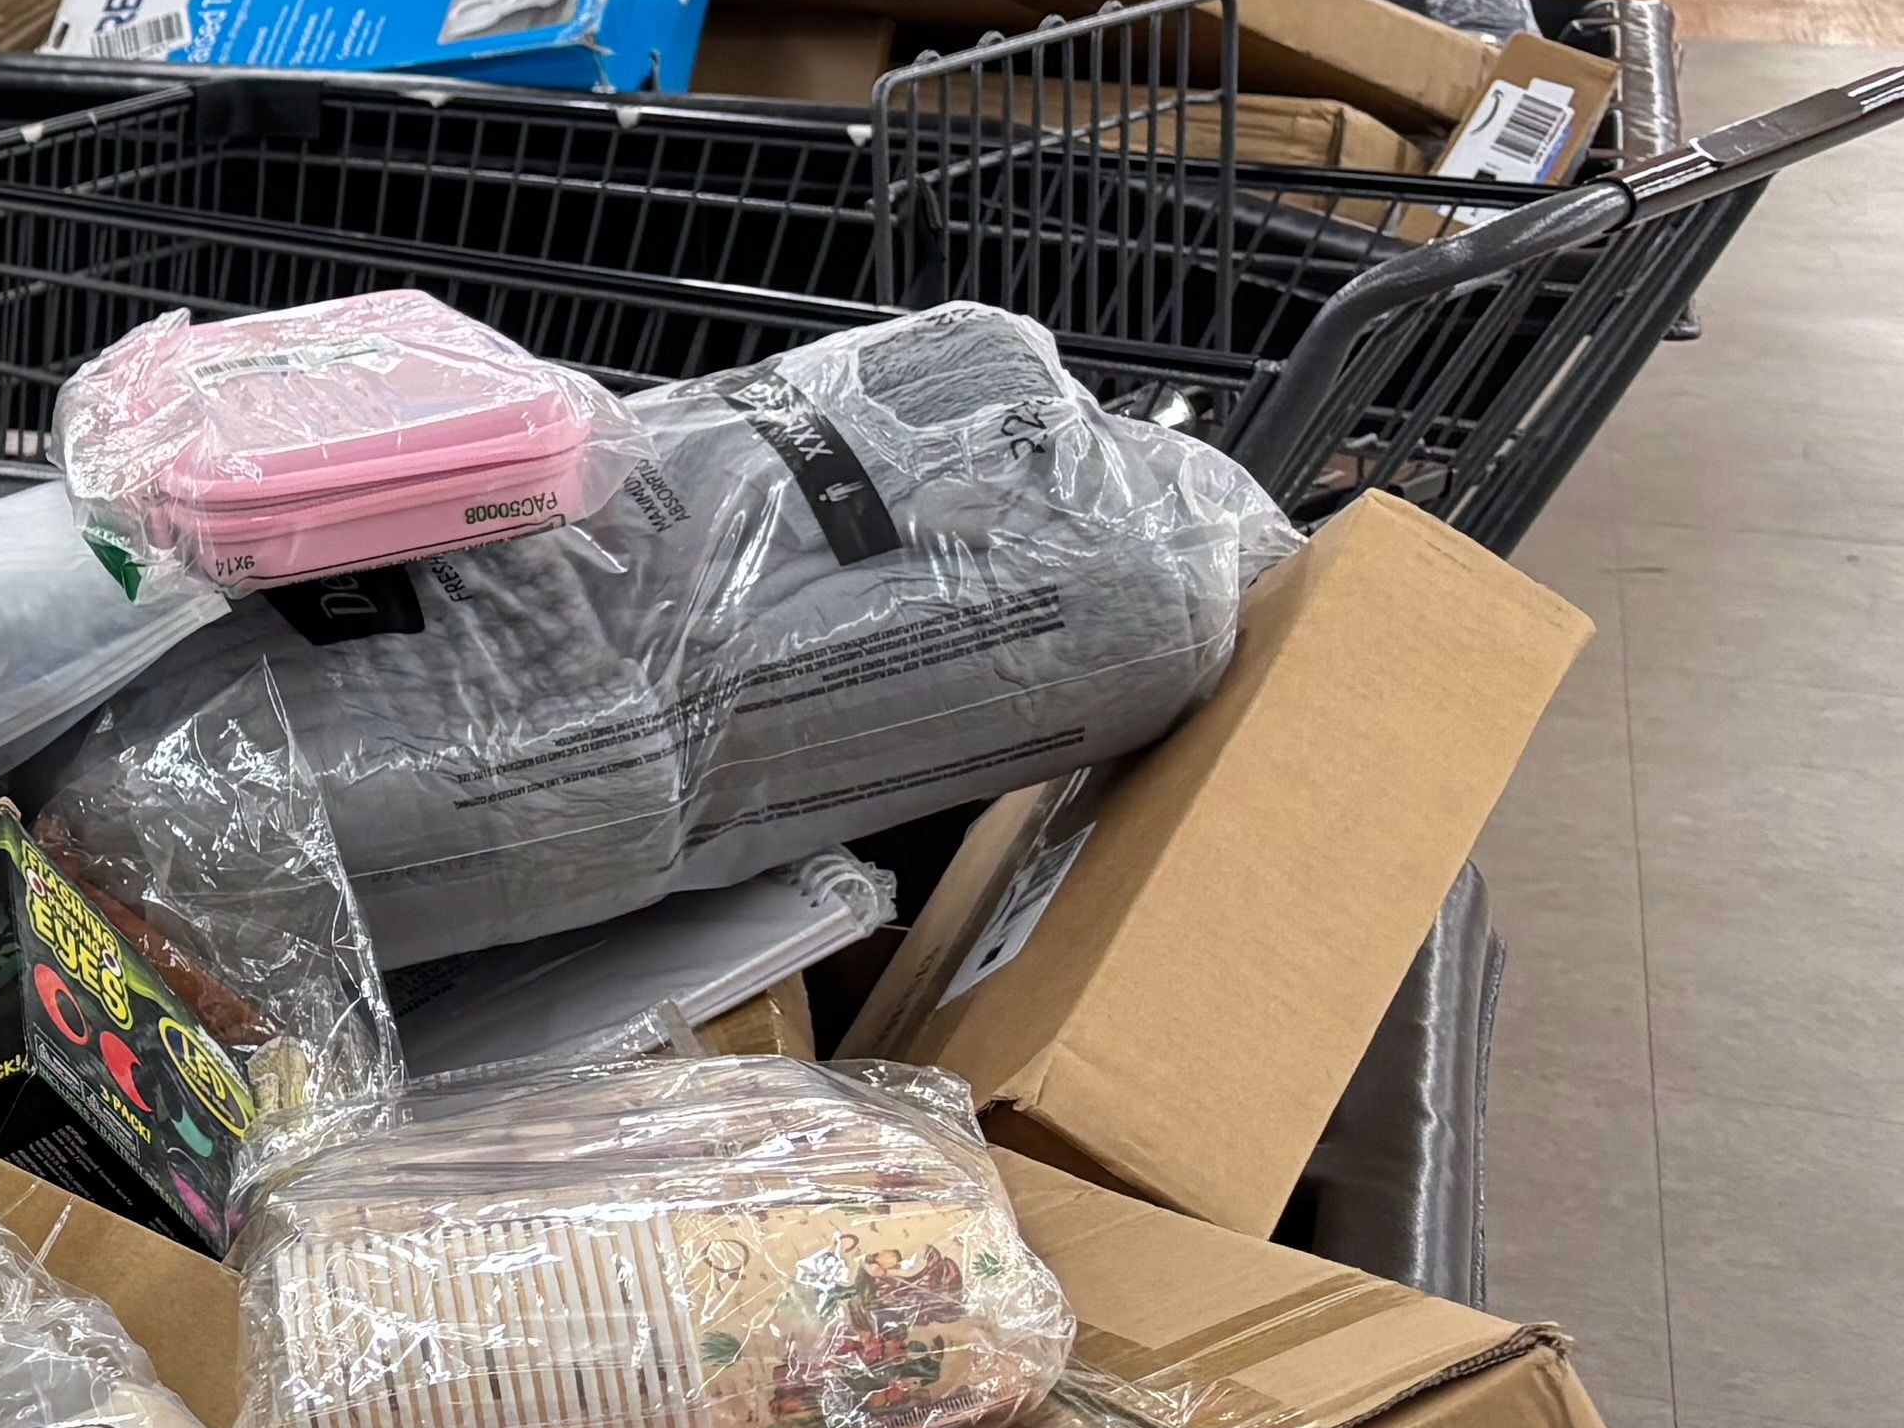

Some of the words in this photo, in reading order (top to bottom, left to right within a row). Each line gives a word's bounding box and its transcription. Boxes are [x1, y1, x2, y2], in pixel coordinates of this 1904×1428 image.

[188, 1, 226, 64] aised
[791, 418, 833, 462] XXL
[623, 473, 673, 534] MAXIMU
[432, 553, 473, 603] FRESH
[26, 849, 117, 952] FLASHING
[45, 892, 103, 954] PEEPING
[182, 1033, 226, 1102] LED
[99, 1085, 111, 1102] 3
[109, 1093, 152, 1146] PACK!
